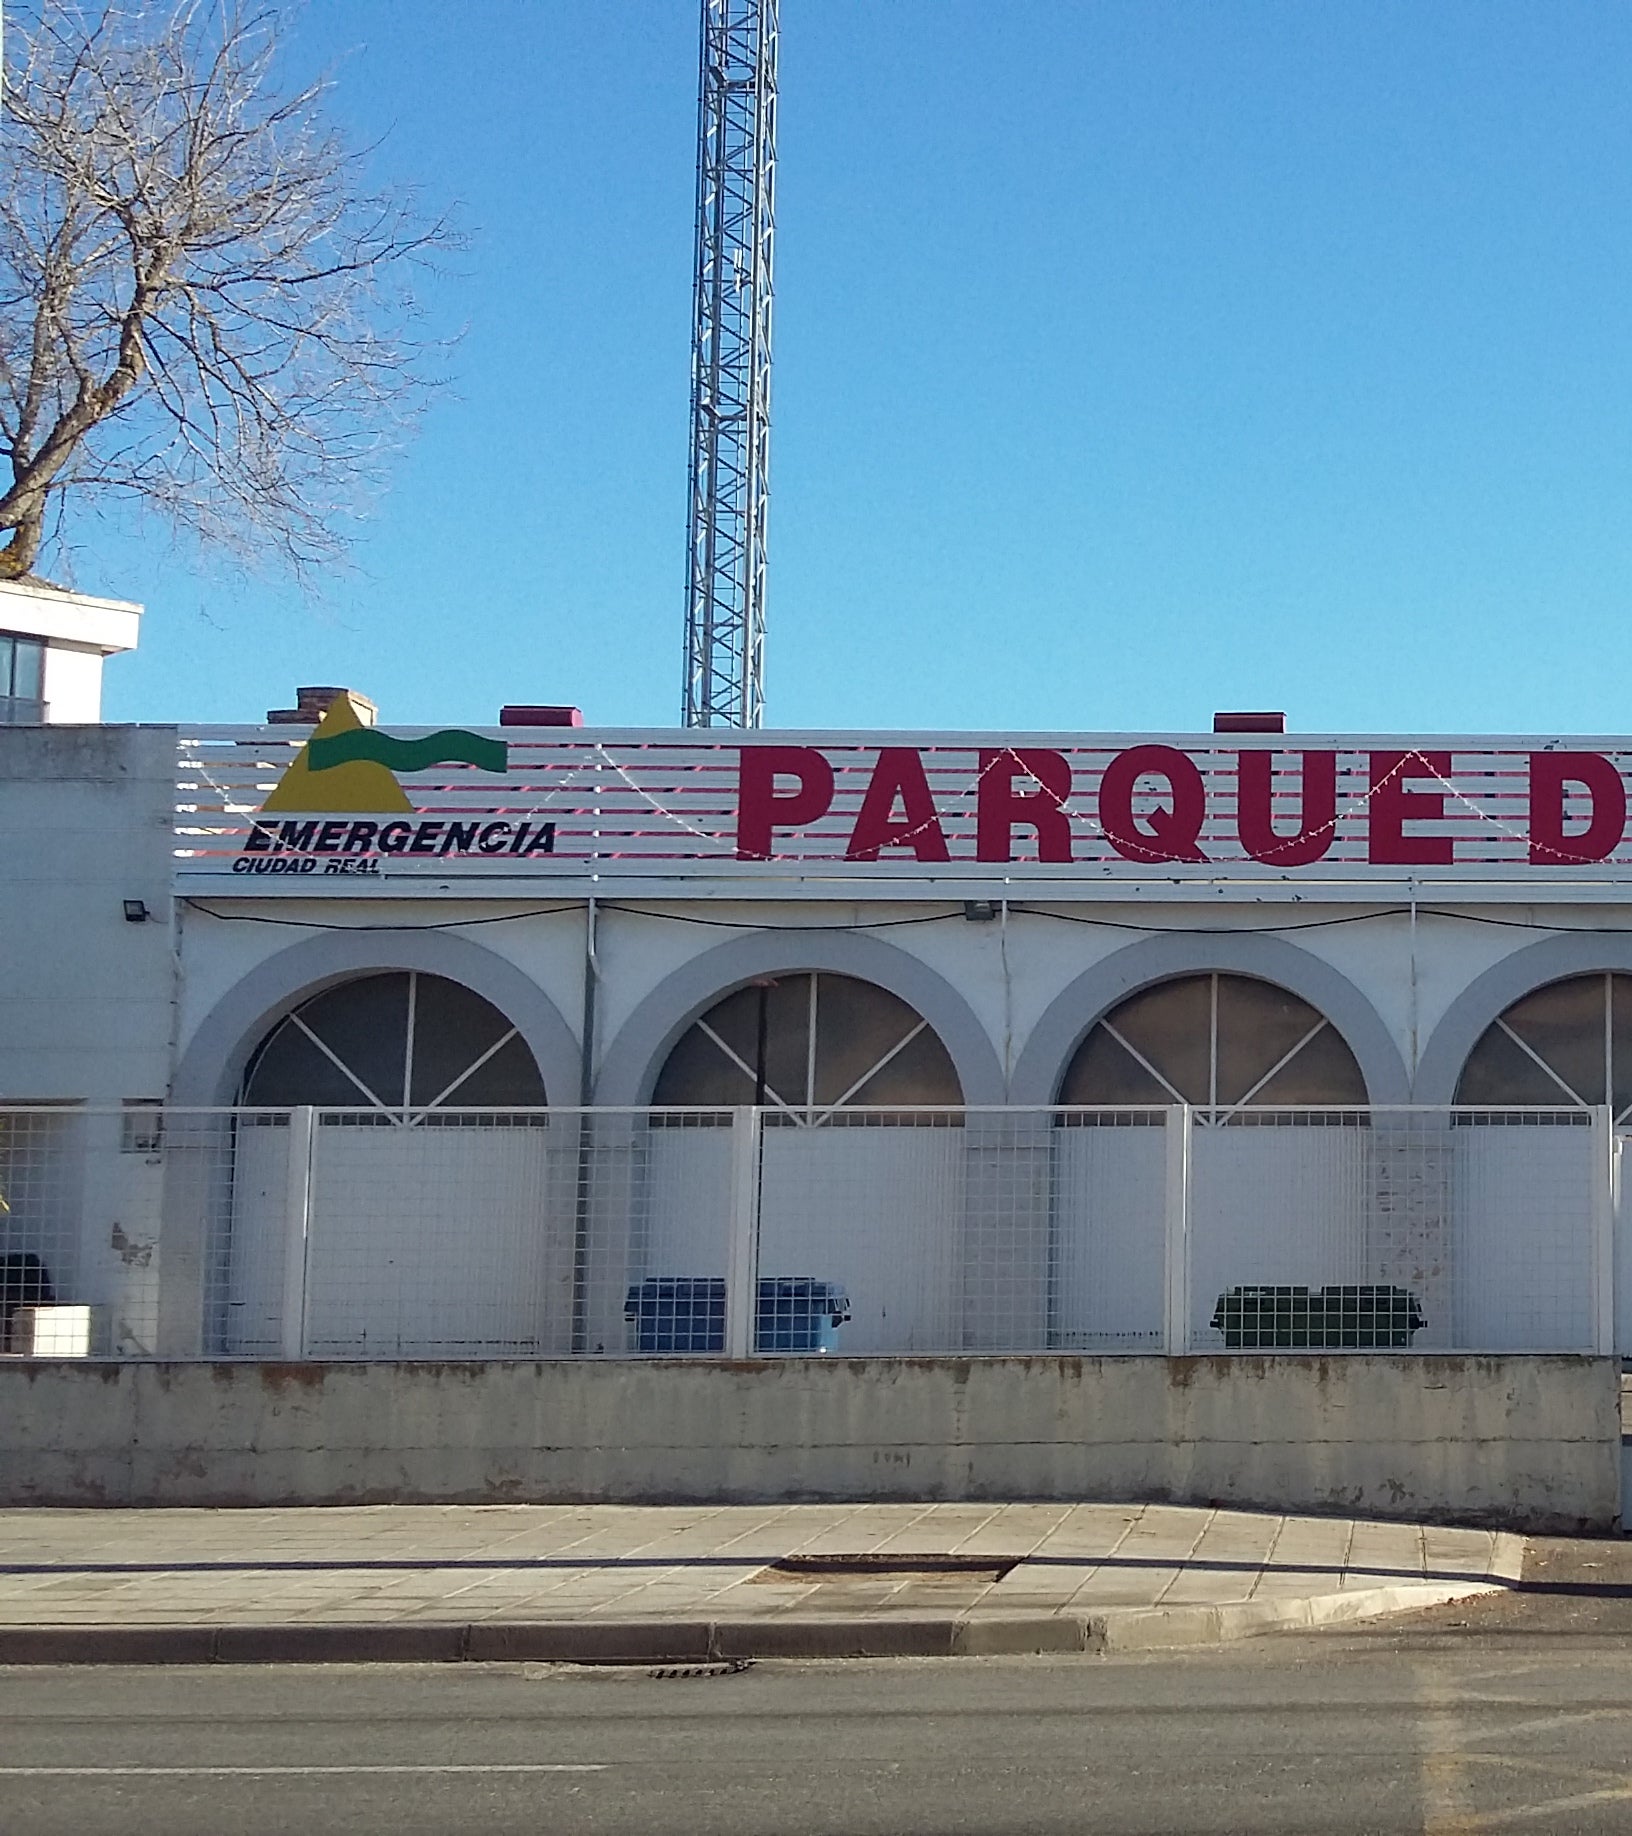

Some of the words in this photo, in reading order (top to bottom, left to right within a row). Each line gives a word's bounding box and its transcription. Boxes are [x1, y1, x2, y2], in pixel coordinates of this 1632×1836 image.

[736, 744, 1454, 867] PARQUE
[243, 820, 557, 854] EMERGENCIA
[231, 857, 317, 875] CIUDAD
[324, 858, 381, 875] REAL
